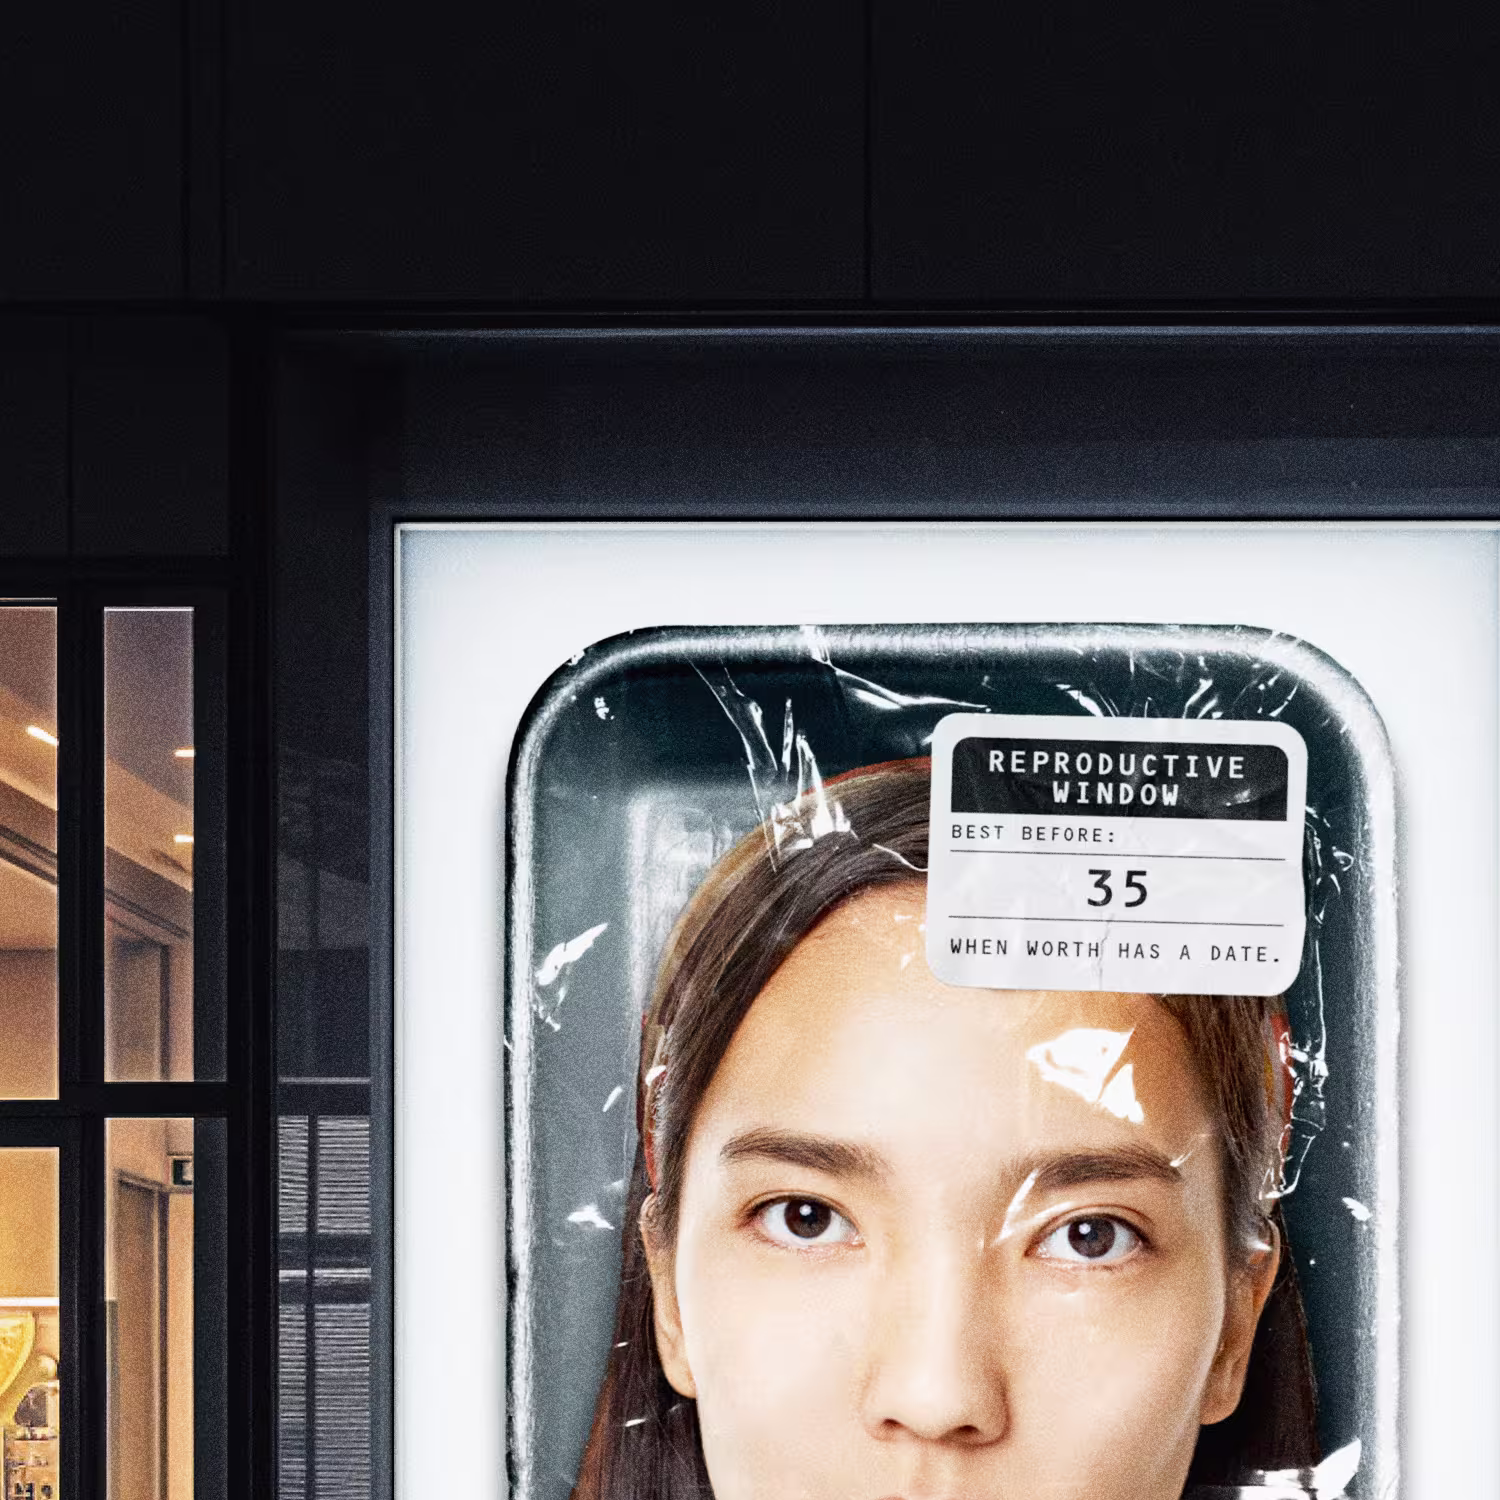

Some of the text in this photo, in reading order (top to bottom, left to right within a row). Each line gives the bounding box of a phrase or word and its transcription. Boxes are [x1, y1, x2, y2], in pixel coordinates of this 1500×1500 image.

[990, 751, 1243, 778] REPRODUCTIVE
[1053, 781, 1178, 805] WINDOW
[952, 825, 1113, 842] BEST BEFORE:
[1088, 870, 1147, 907] 35
[951, 939, 1278, 962] WHEN WORTH HAS A DATE.
